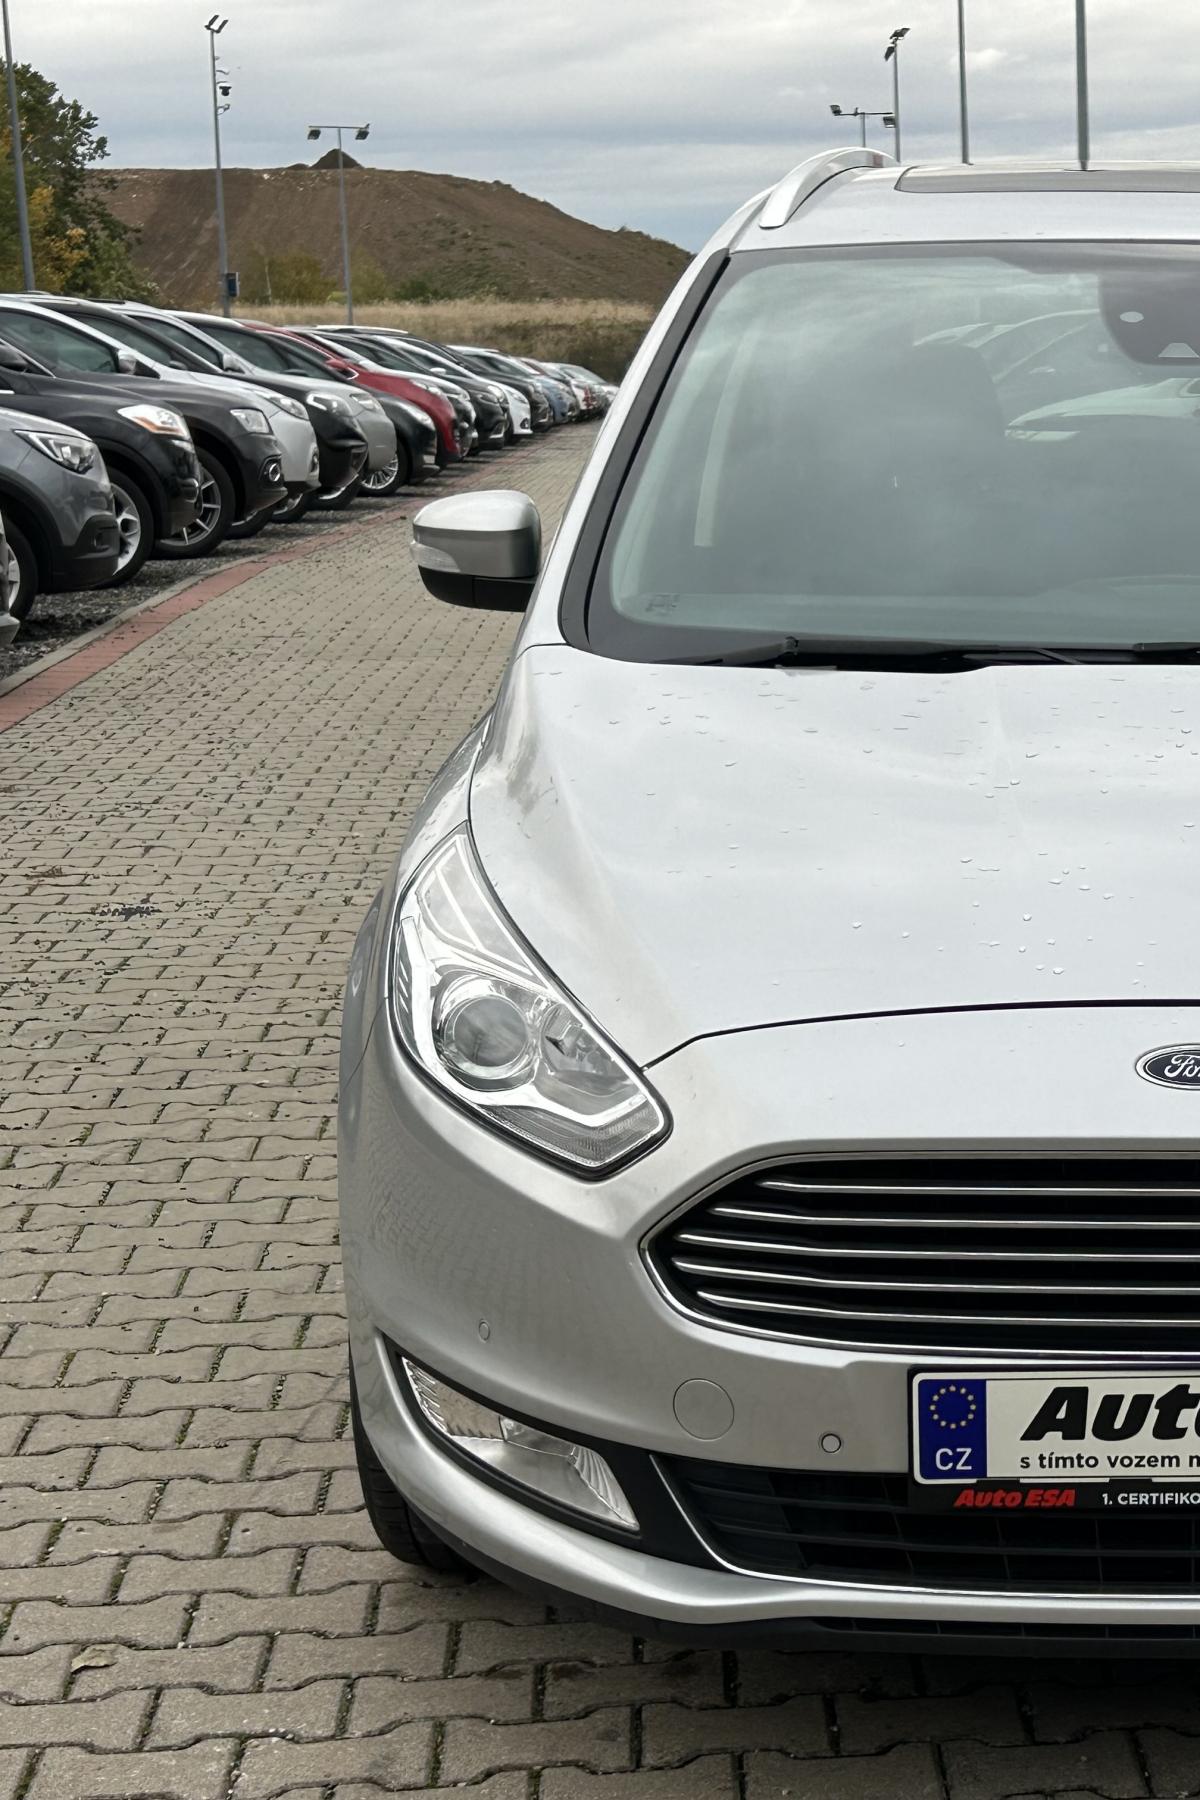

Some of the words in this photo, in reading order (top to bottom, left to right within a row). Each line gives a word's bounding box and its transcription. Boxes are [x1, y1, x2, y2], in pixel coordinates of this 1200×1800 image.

[935, 1448, 972, 1471] CZ
[1019, 1454, 1031, 1469] s
[1038, 1451, 1099, 1469] tímto
[1107, 1454, 1181, 1469] vozem
[954, 1489, 1023, 1508] Auto
[1024, 1489, 1076, 1508] ESA
[1102, 1494, 1113, 1505] 1.
